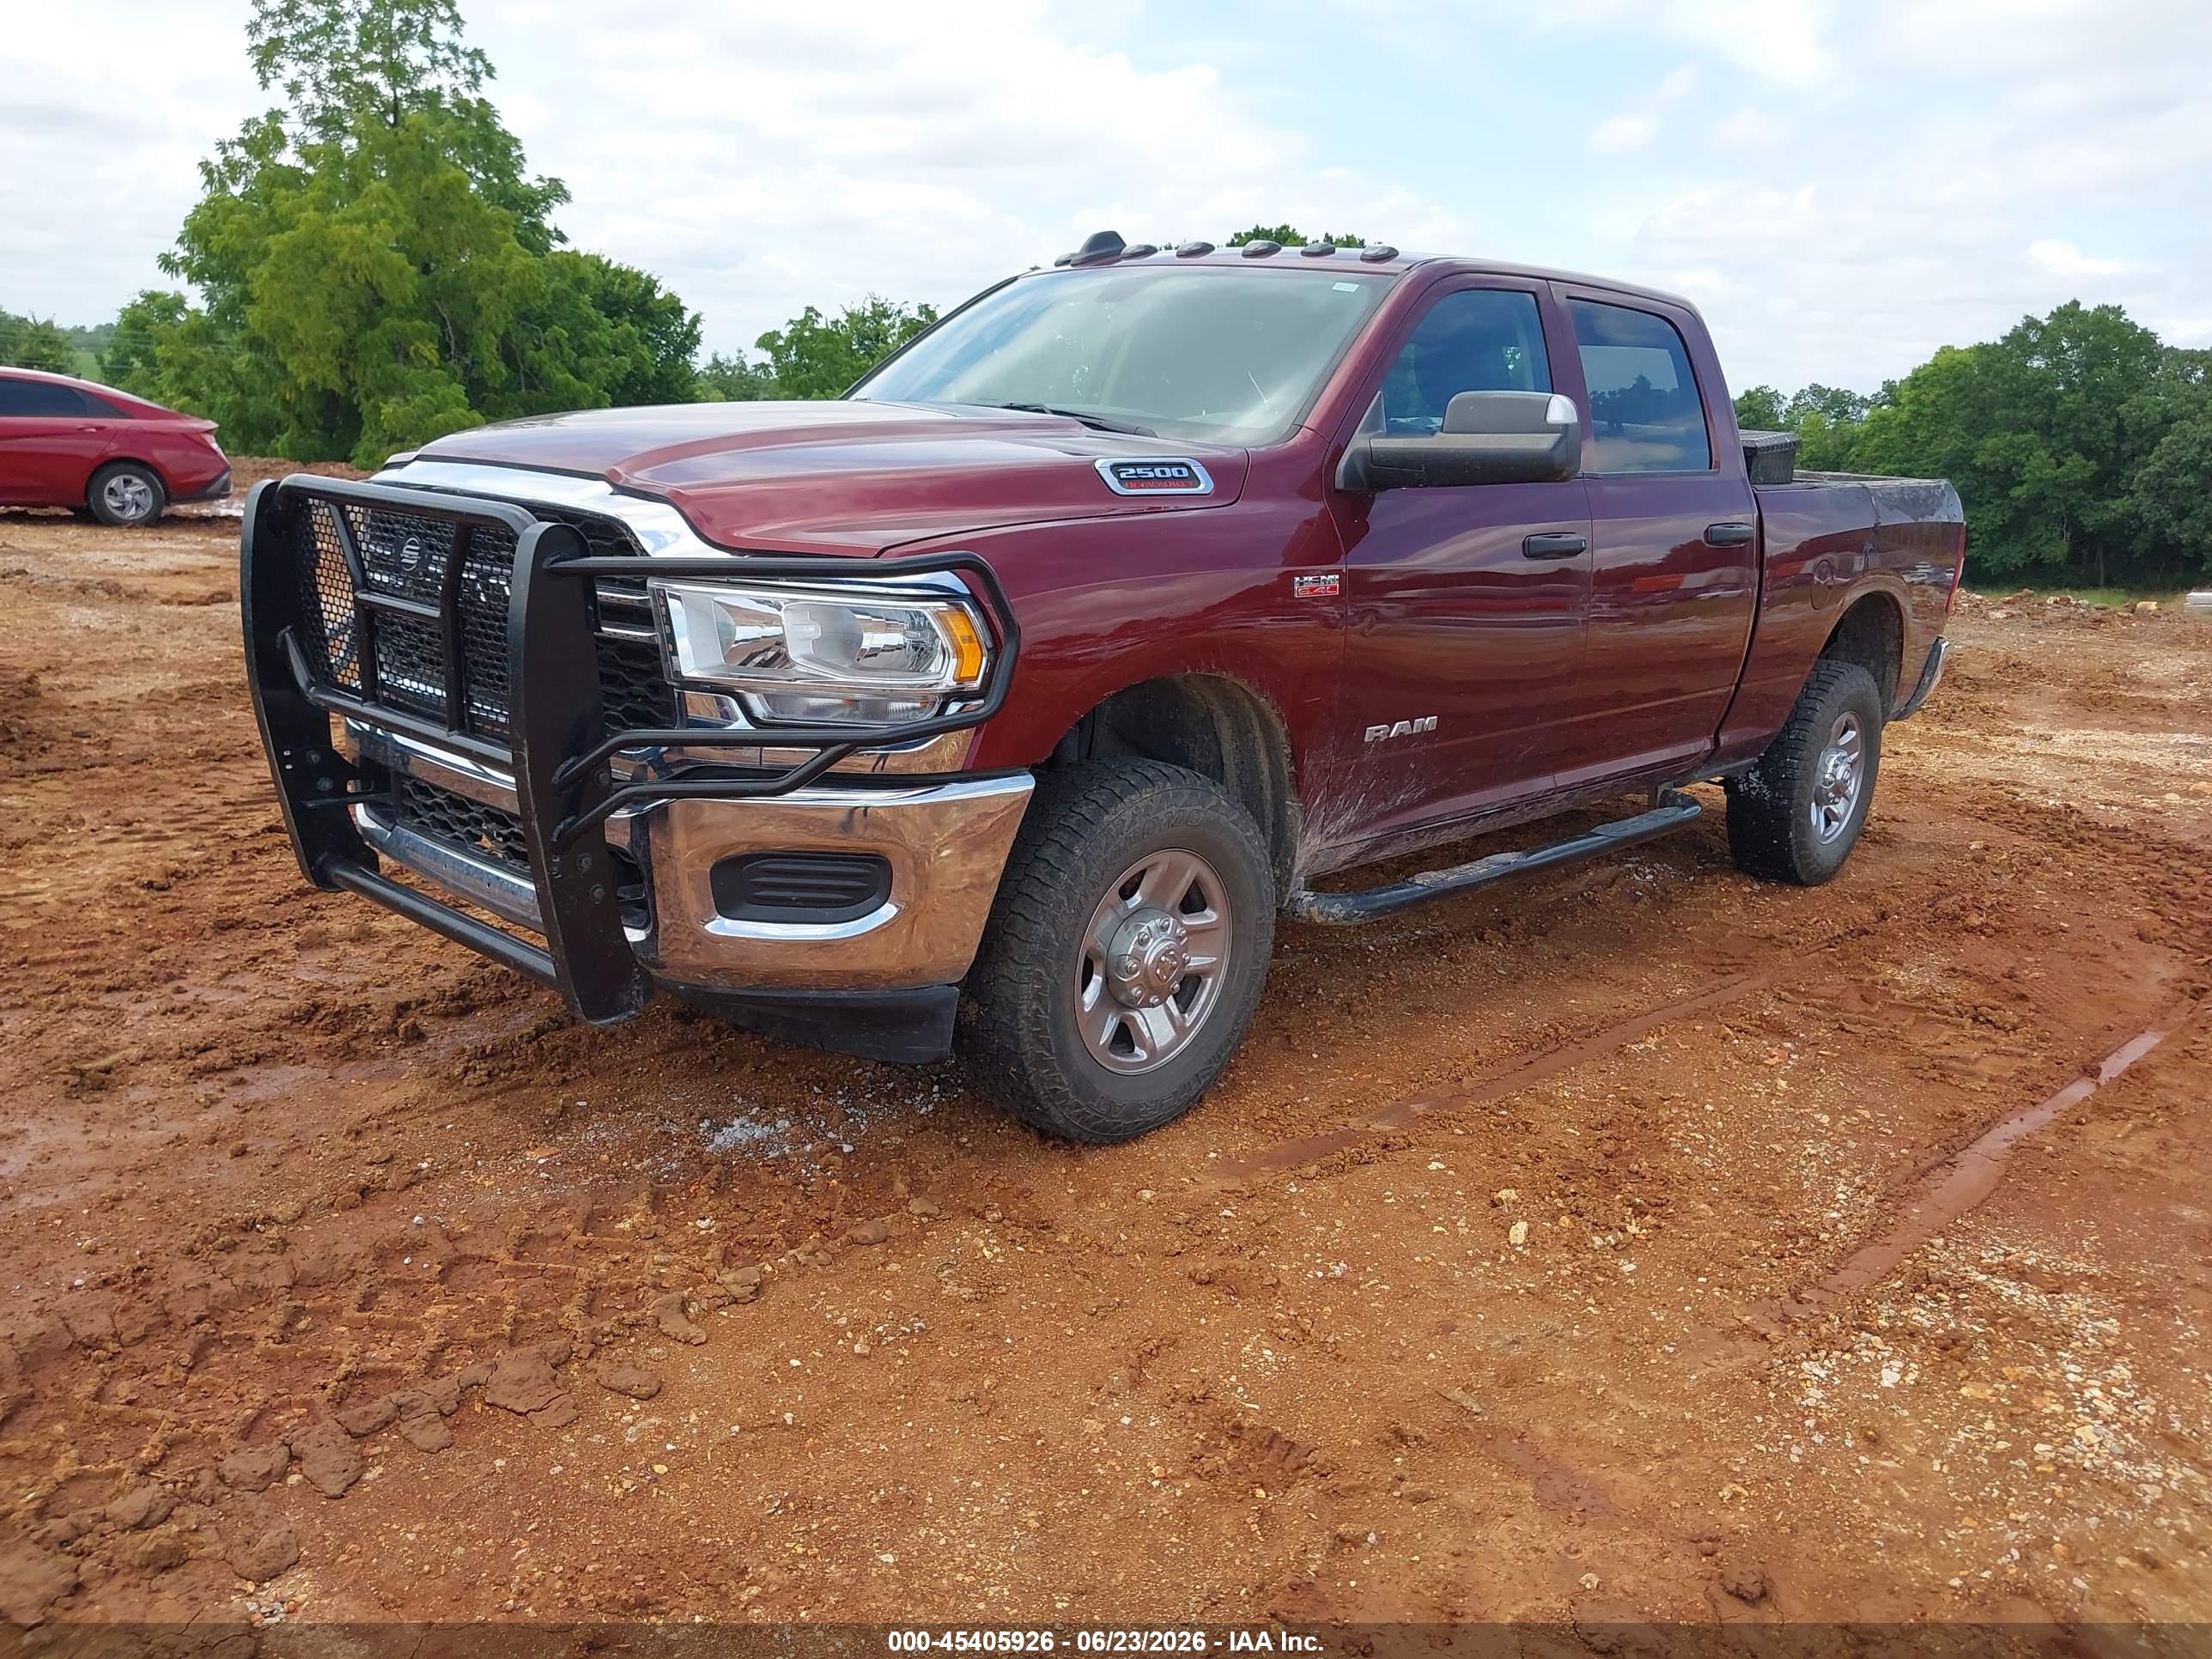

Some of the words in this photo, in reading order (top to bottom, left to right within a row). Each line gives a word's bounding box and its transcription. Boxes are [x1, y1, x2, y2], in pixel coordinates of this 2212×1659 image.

[1118, 467, 1189, 479] 2500
[1293, 574, 1340, 586] HEMI
[1364, 715, 1438, 743] RAM
